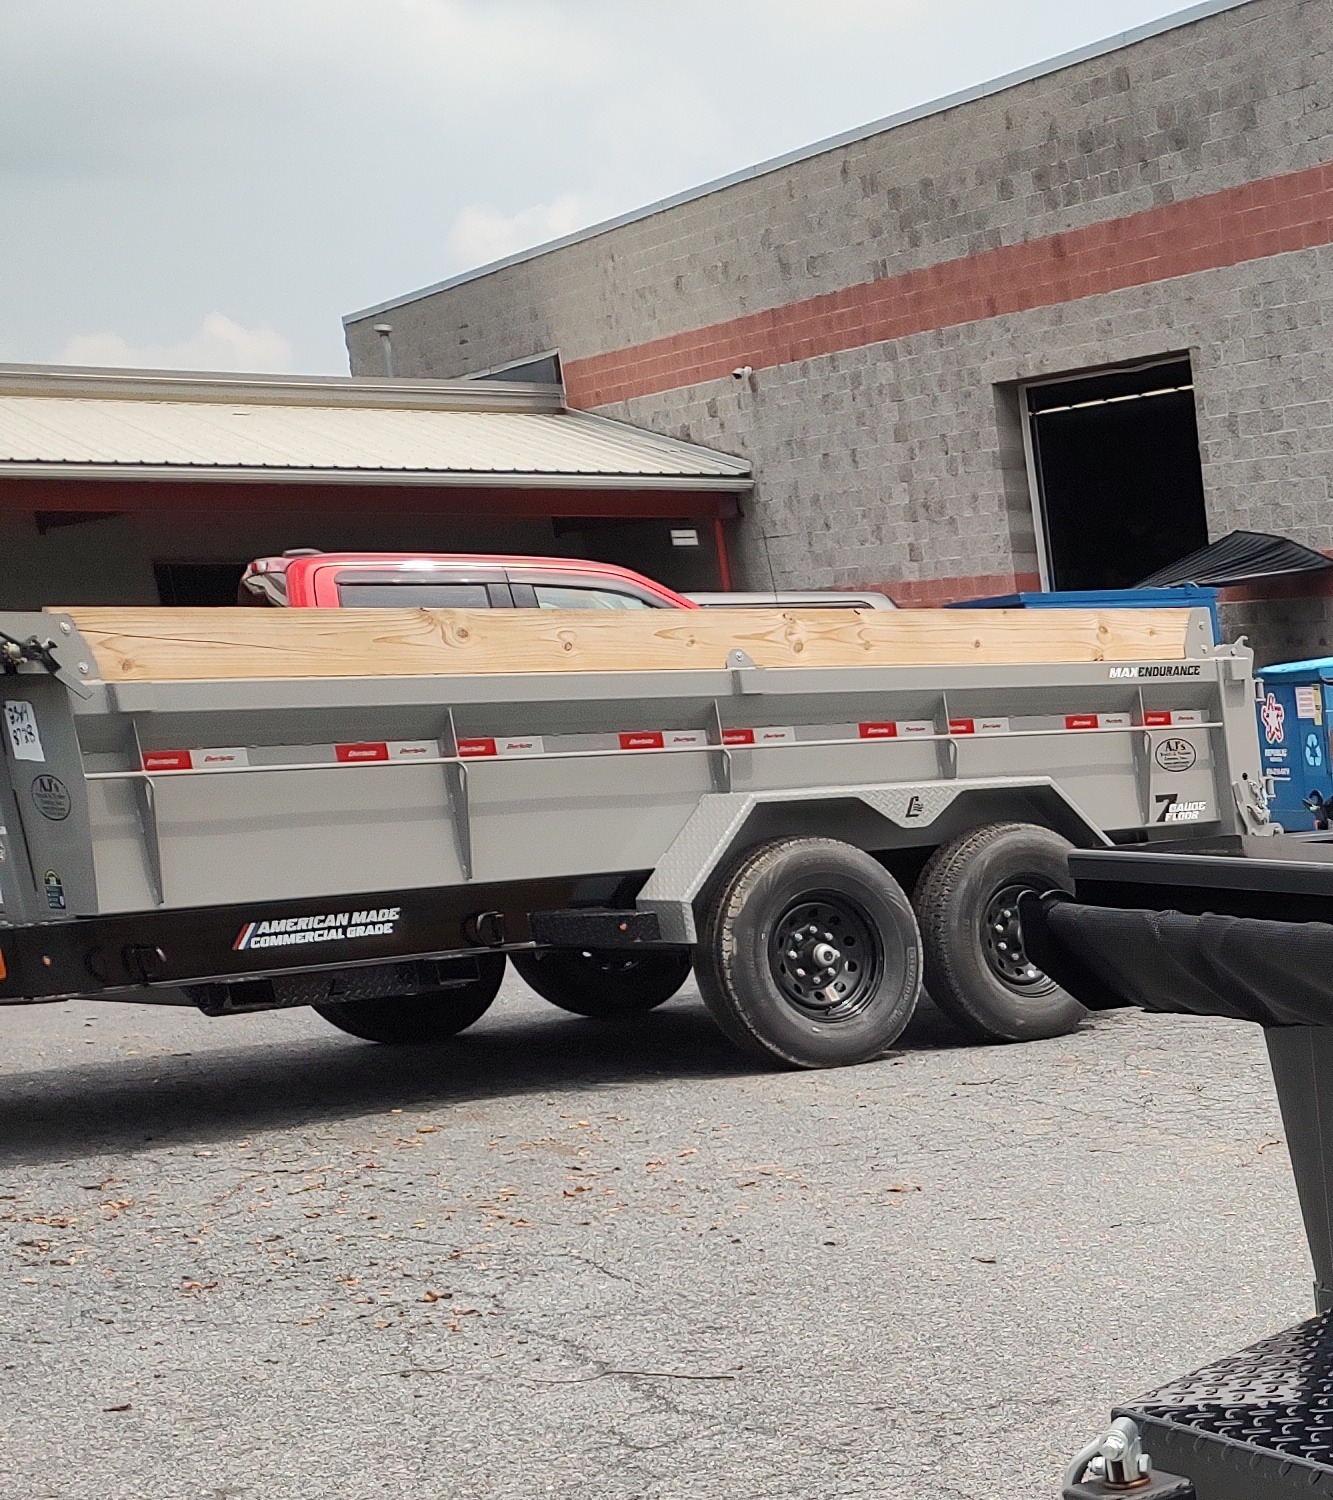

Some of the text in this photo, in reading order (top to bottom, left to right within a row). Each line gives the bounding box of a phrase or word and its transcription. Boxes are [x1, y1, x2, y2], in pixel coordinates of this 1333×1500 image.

[1155, 794, 1178, 822] 7
[1165, 811, 1199, 822] FLOOR
[1168, 801, 1206, 813] GAUGE
[257, 907, 401, 935] AMERICAN MADE
[251, 923, 393, 949] COMMERCIAL GRADE
